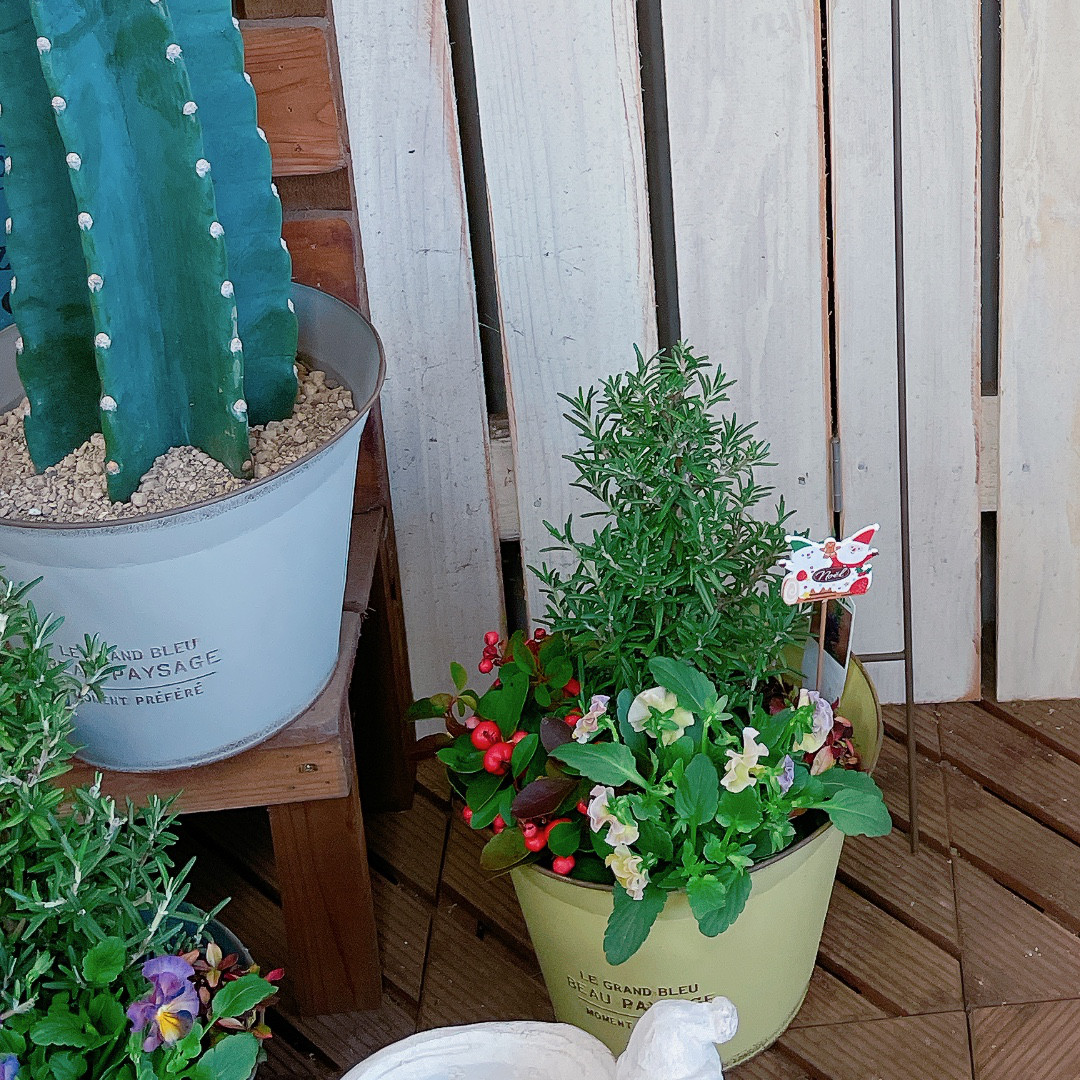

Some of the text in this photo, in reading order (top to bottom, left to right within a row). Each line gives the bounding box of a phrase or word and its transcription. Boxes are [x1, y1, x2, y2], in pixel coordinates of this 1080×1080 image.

[59, 644, 79, 658] LE
[149, 638, 198, 659] BLEU
[136, 682, 204, 706] PRÉFÉRÉ
[567, 975, 611, 1004] BEAU
[580, 970, 699, 997] LE GRAND BLEU
[586, 1006, 632, 1029] MOMENT
